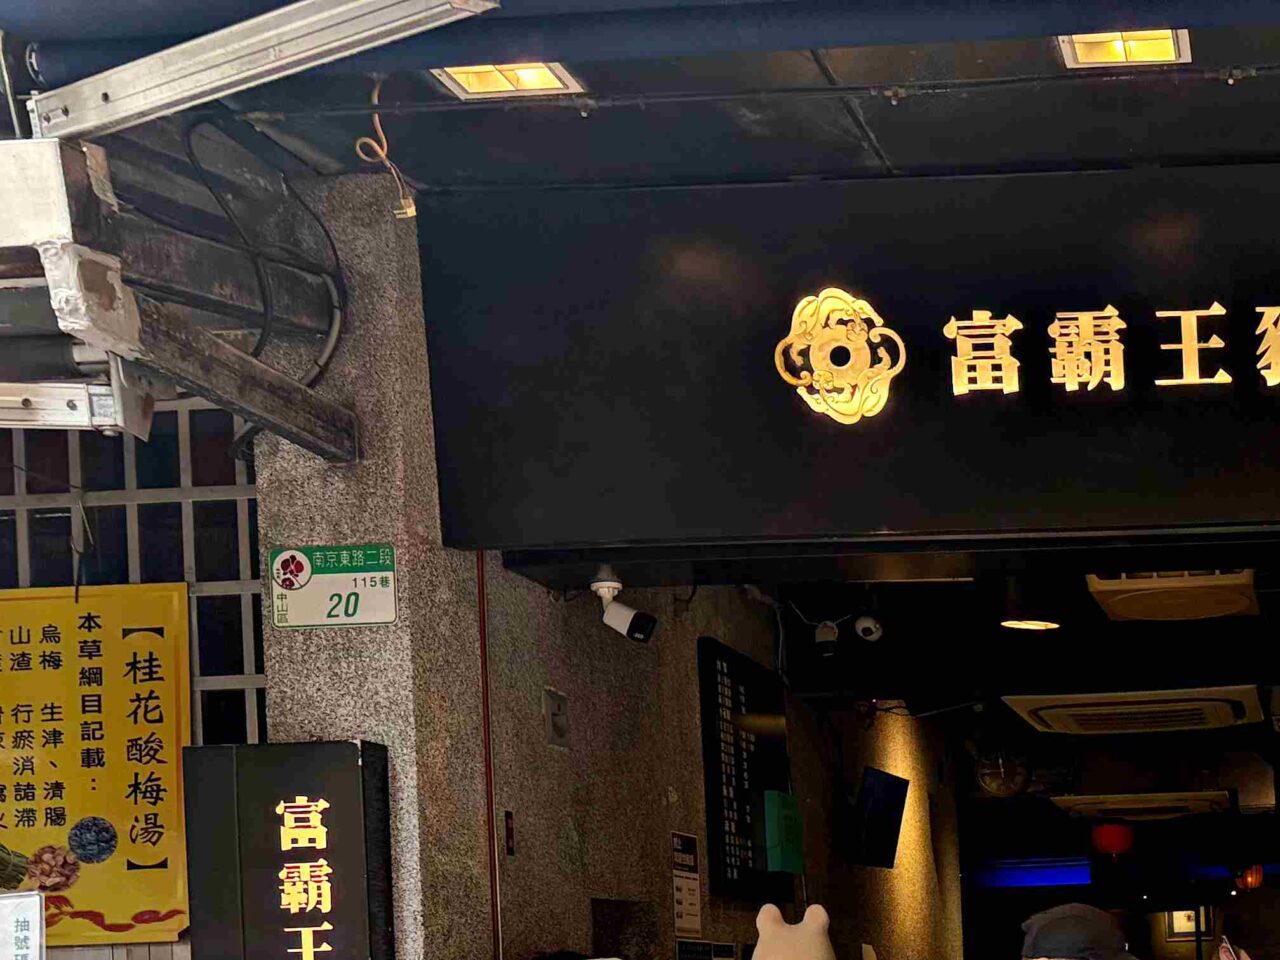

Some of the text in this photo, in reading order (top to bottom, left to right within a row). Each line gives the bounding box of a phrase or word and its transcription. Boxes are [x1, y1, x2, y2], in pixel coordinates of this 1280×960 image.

[312, 548, 392, 568] 南京東路二段
[352, 576, 391, 588] 115巷
[276, 592, 288, 624] 中山區
[326, 592, 360, 619] 20
[9, 625, 33, 672] 山渣
[38, 624, 64, 671] 烏梅
